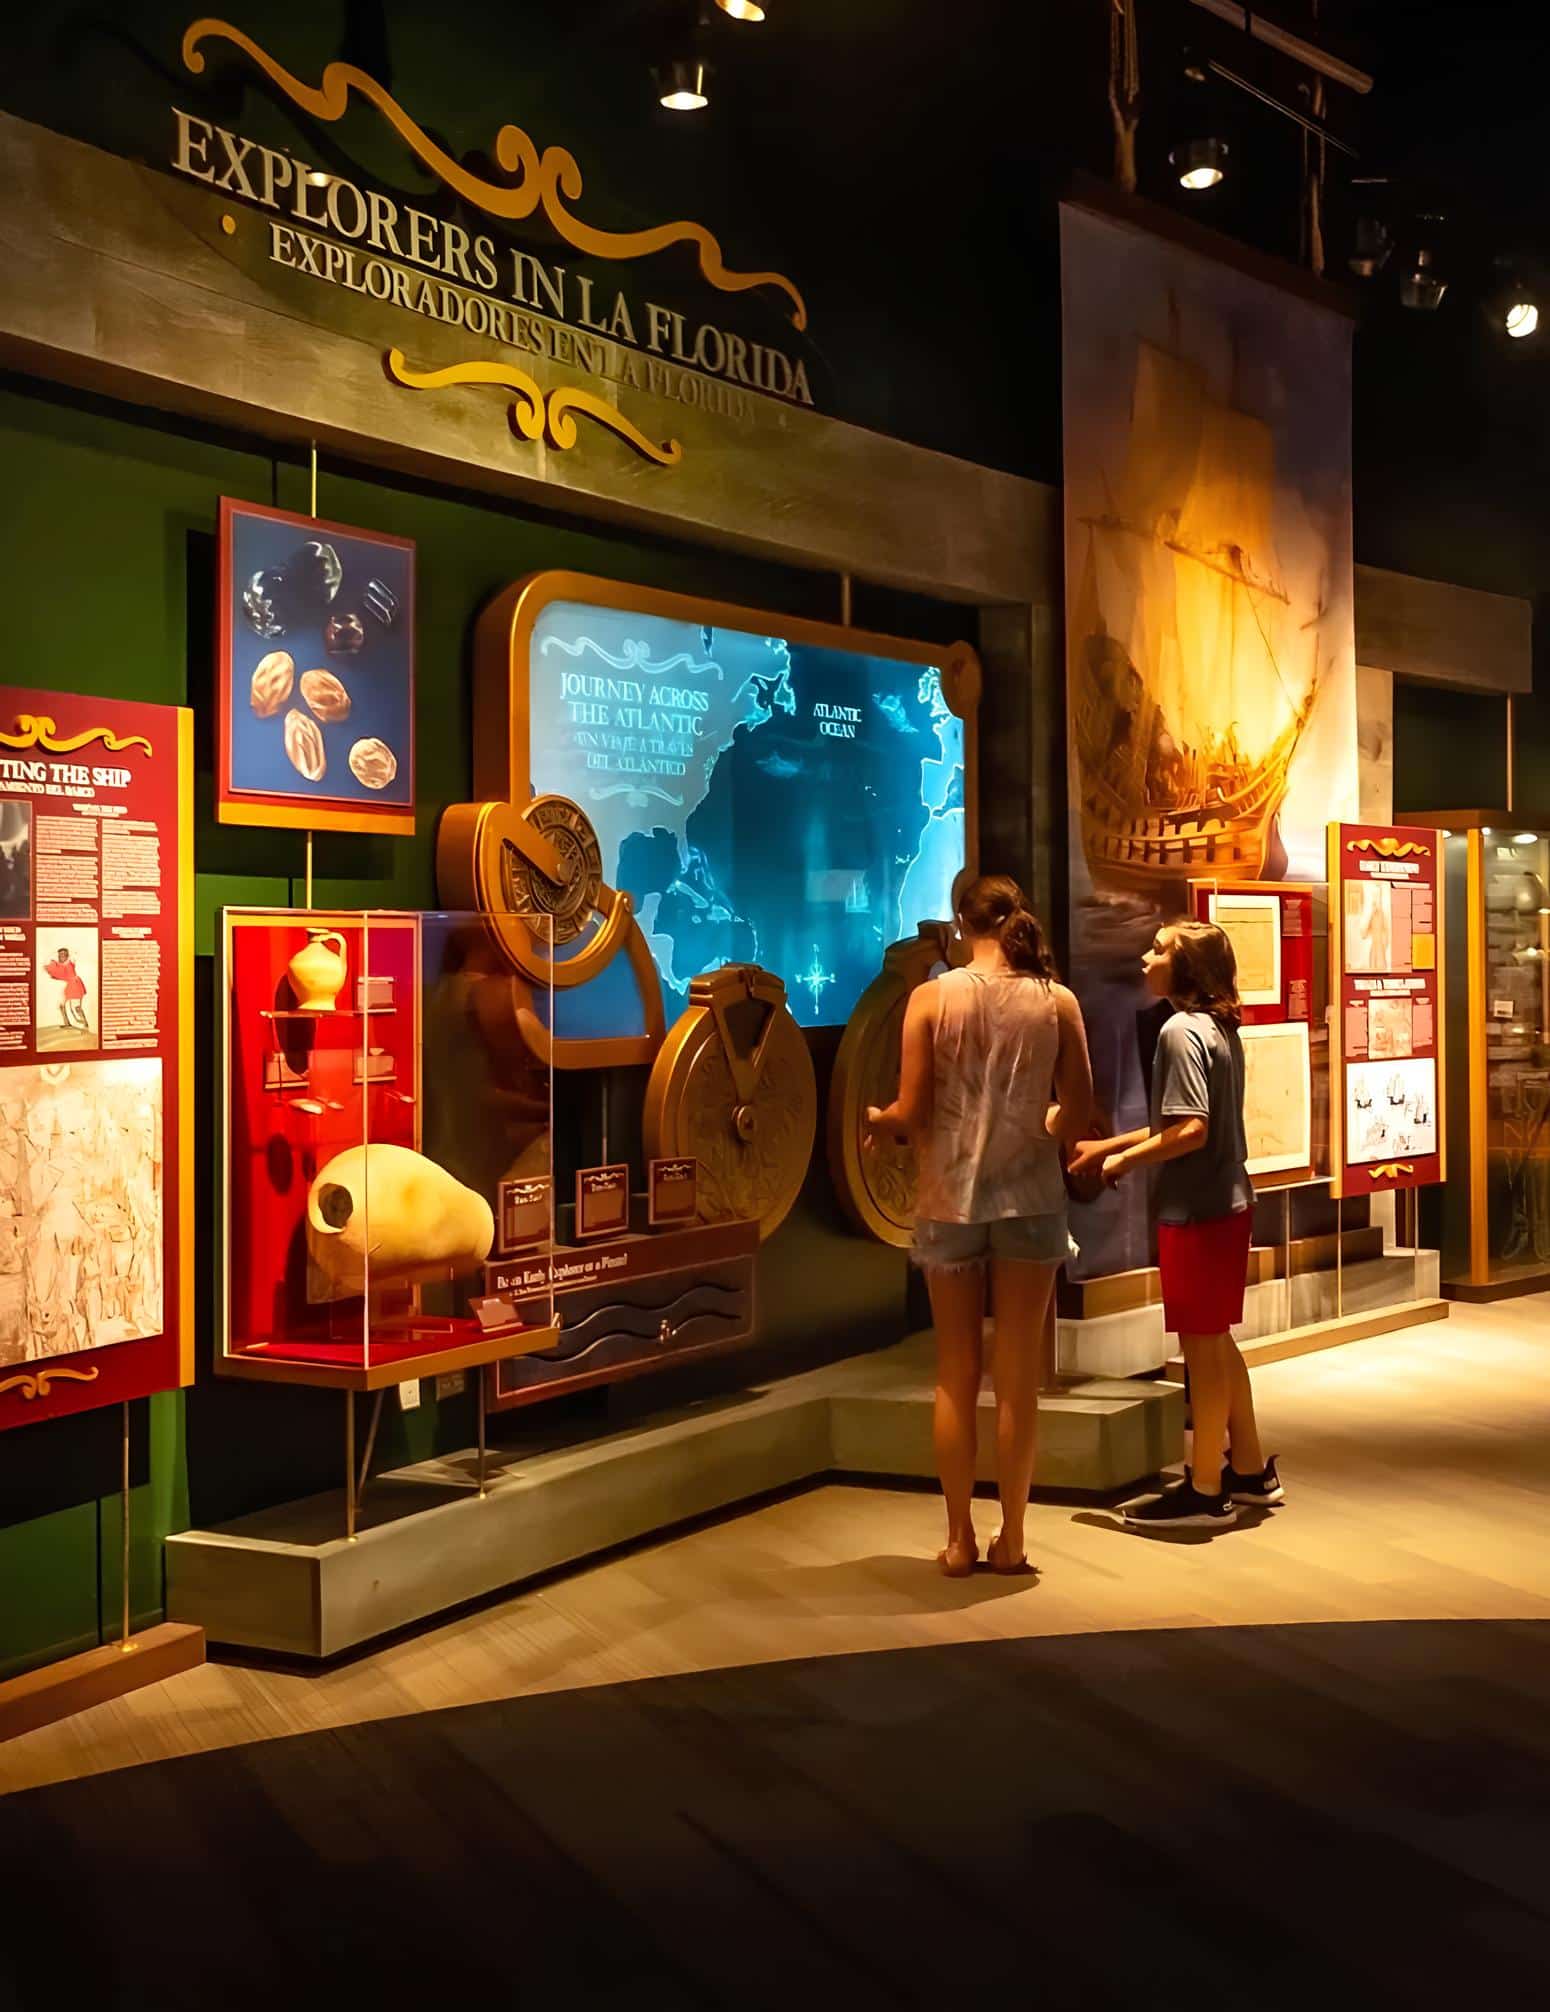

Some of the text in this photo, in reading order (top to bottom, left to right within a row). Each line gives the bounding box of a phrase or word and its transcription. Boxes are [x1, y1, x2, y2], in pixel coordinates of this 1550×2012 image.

[171, 106, 815, 405] EXPLORERS IN LA FLORIDA
[269, 222, 756, 424] EXPLORADORES EN LA FLORIDA
[560, 672, 709, 712] JOURNEY ACROSS
[567, 700, 703, 736] THE ATLANTIC
[813, 703, 862, 738] ATLANTIC OCEAN
[49, 763, 90, 785] THE
[92, 767, 131, 788] SHIP
